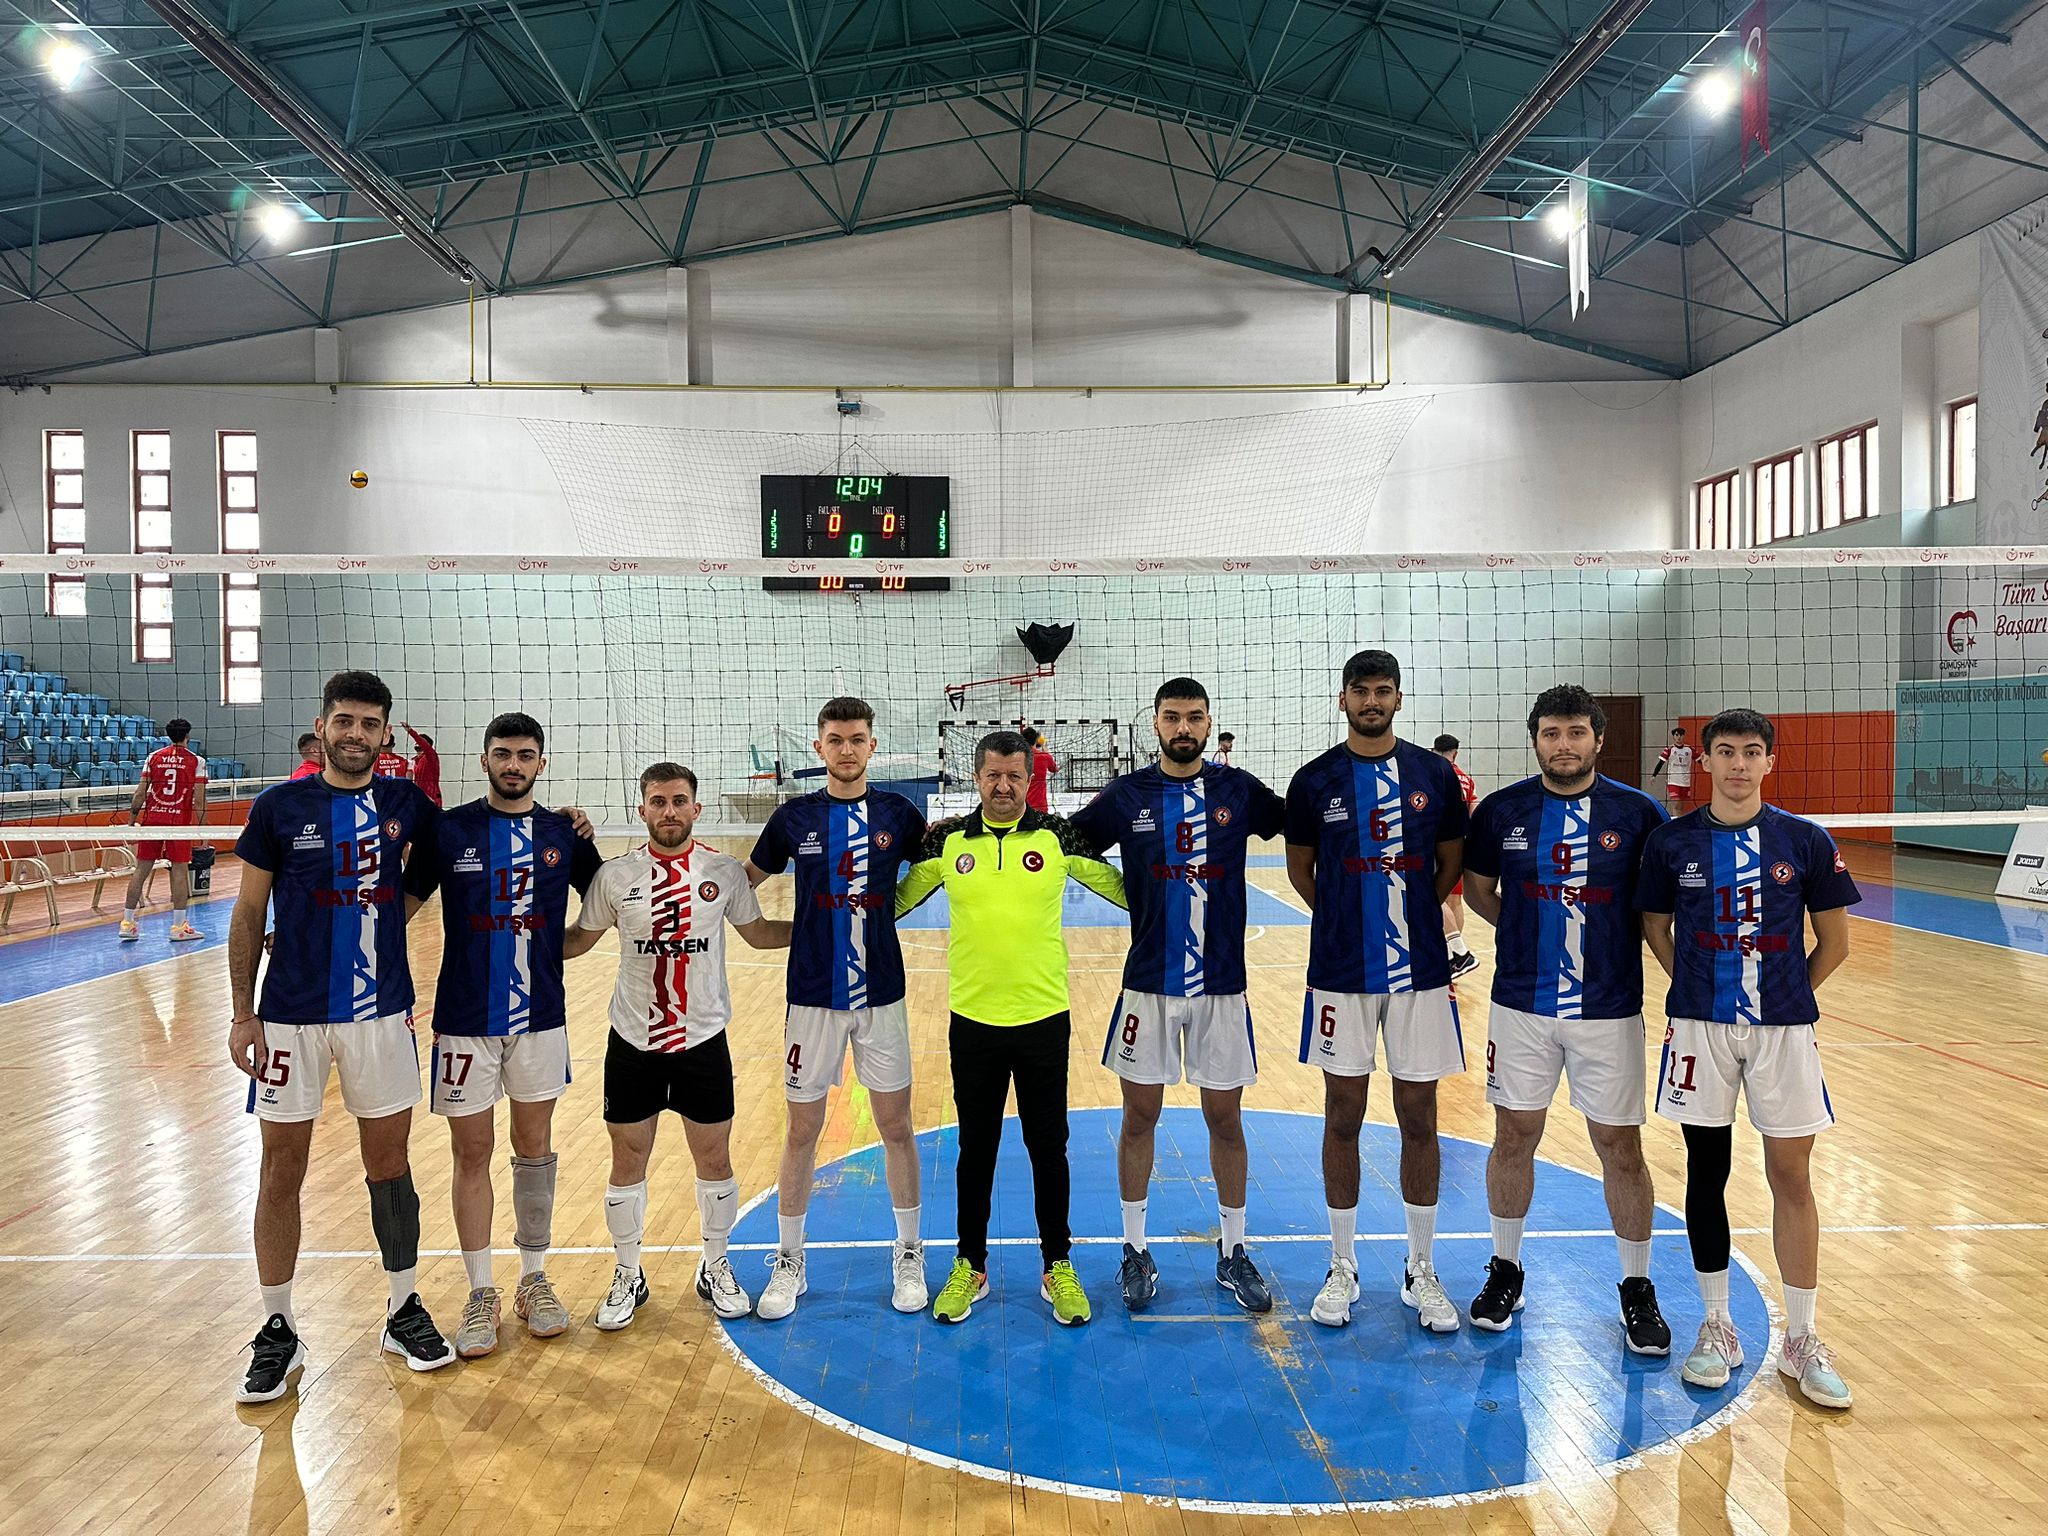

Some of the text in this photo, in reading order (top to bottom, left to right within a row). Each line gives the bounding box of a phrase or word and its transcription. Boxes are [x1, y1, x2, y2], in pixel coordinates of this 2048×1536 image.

[829, 514, 841, 532] 0
[883, 514, 895, 532] 0
[850, 534, 863, 552] 0
[1847, 553, 1863, 561] TVF
[2019, 551, 2034, 559] TVF
[79, 560, 96, 568] TVF
[260, 560, 276, 568] TVF
[532, 561, 548, 569] TVF
[2002, 583, 2035, 606] Tüm
[1994, 614, 2047, 641] Başarı
[163, 769, 177, 796] 3
[1175, 821, 1194, 854] 8
[1369, 808, 1389, 842] 6
[336, 839, 377, 877] 15
[836, 851, 857, 881] 4
[1551, 842, 1572, 876] 9
[494, 867, 530, 902] 17
[661, 900, 680, 933] 3
[1715, 885, 1759, 923] 11
[633, 937, 709, 959] TATŞEN
[1695, 931, 1790, 957] TATŞEN
[1122, 1013, 1139, 1046] 8
[1319, 1005, 1336, 1038] 6
[442, 1052, 473, 1086] 17
[786, 1042, 802, 1075] 4
[1487, 1039, 1496, 1073] 9
[1668, 1051, 1697, 1092] 11
